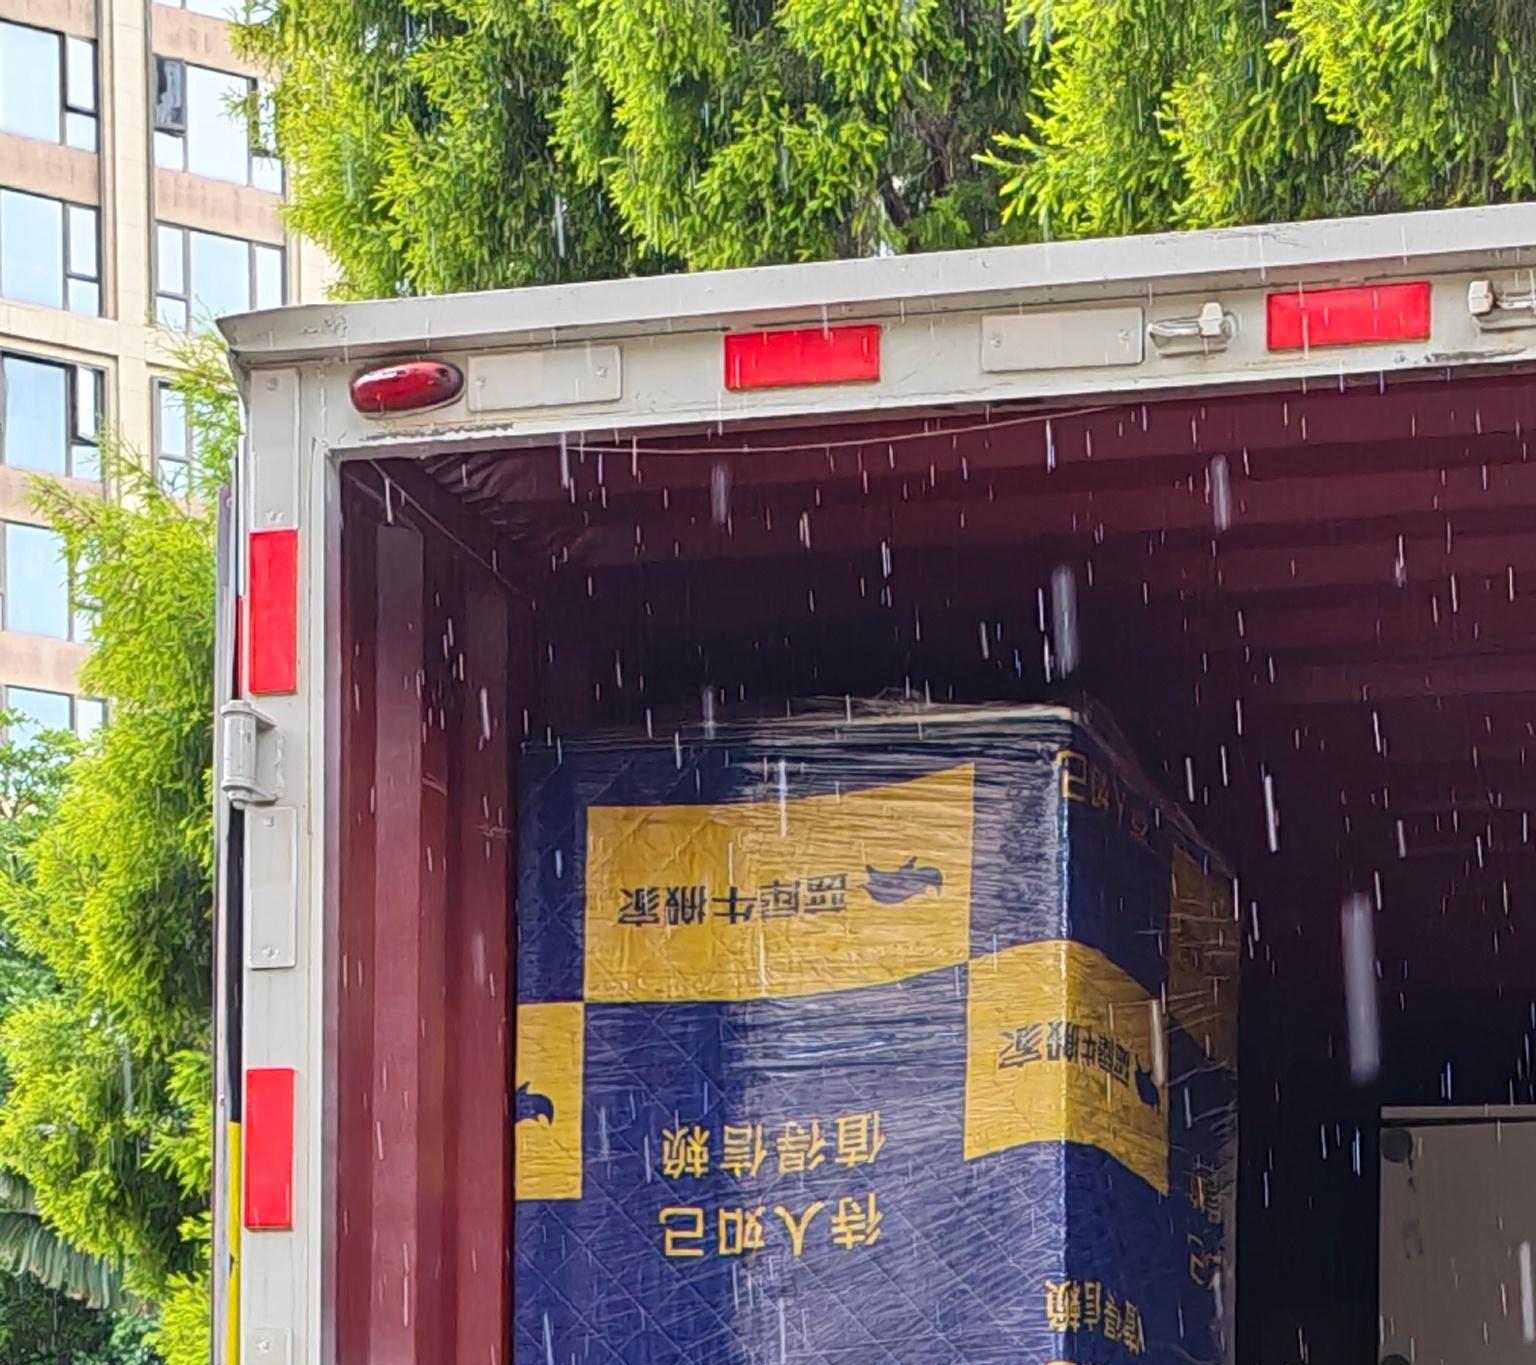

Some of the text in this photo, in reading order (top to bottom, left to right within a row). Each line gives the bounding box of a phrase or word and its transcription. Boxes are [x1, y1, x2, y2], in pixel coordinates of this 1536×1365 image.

[617, 873, 847, 927] 蓝犀牛搬家
[662, 1110, 887, 1179] 值得信赖
[659, 1193, 884, 1257] 待人如己
[1045, 1279, 1146, 1355] 值得信赖
